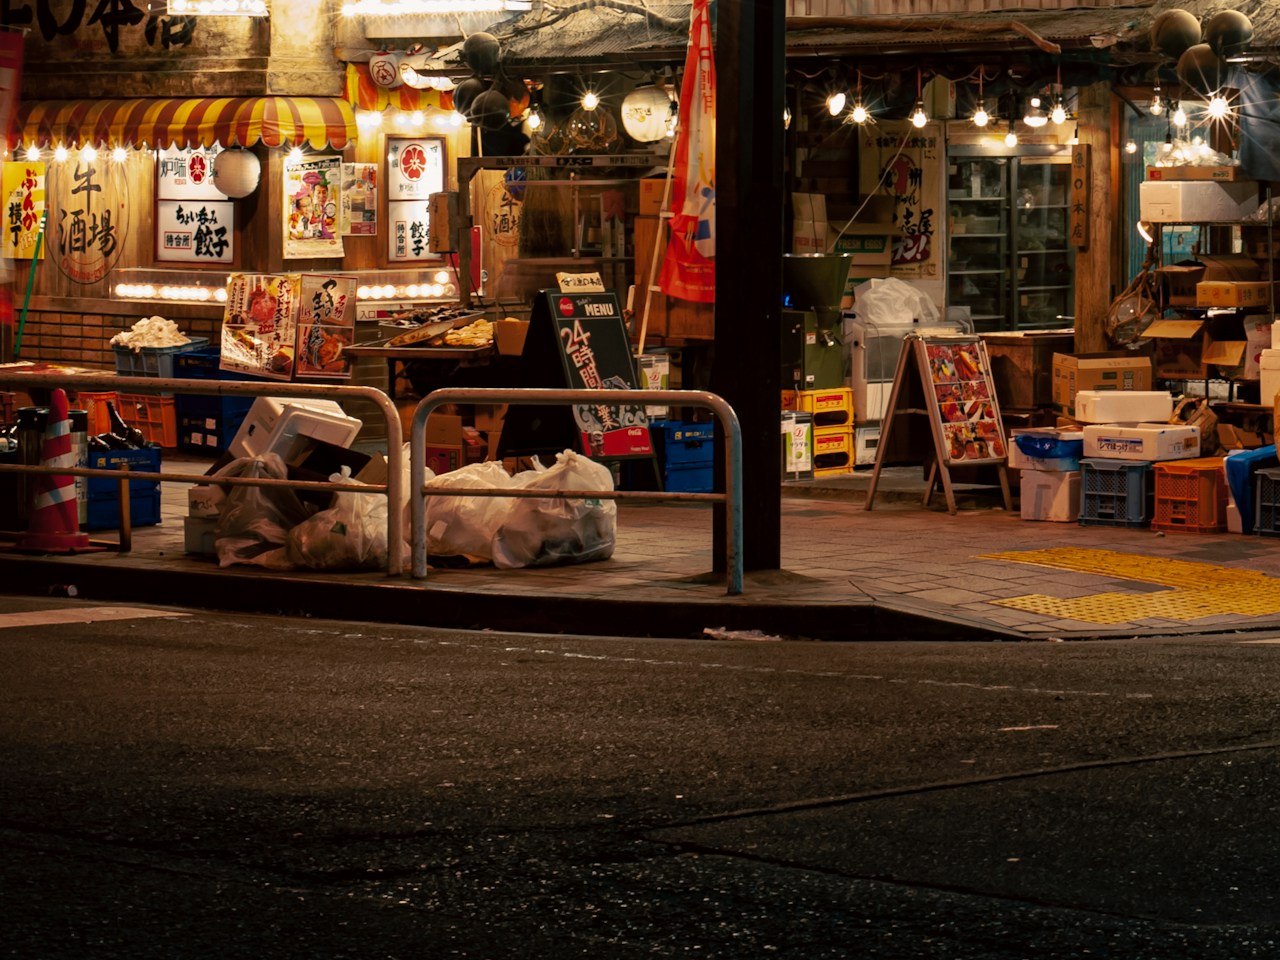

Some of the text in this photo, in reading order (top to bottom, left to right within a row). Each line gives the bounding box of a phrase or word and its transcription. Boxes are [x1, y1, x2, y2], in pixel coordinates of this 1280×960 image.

[21, 169, 38, 232] ぶんか
[71, 161, 102, 216] 牛
[9, 202, 23, 248] 横丁
[58, 208, 118, 258] 酒場
[193, 224, 230, 258] 餃子
[410, 221, 425, 257] 餃子
[584, 303, 614, 316] MENU
